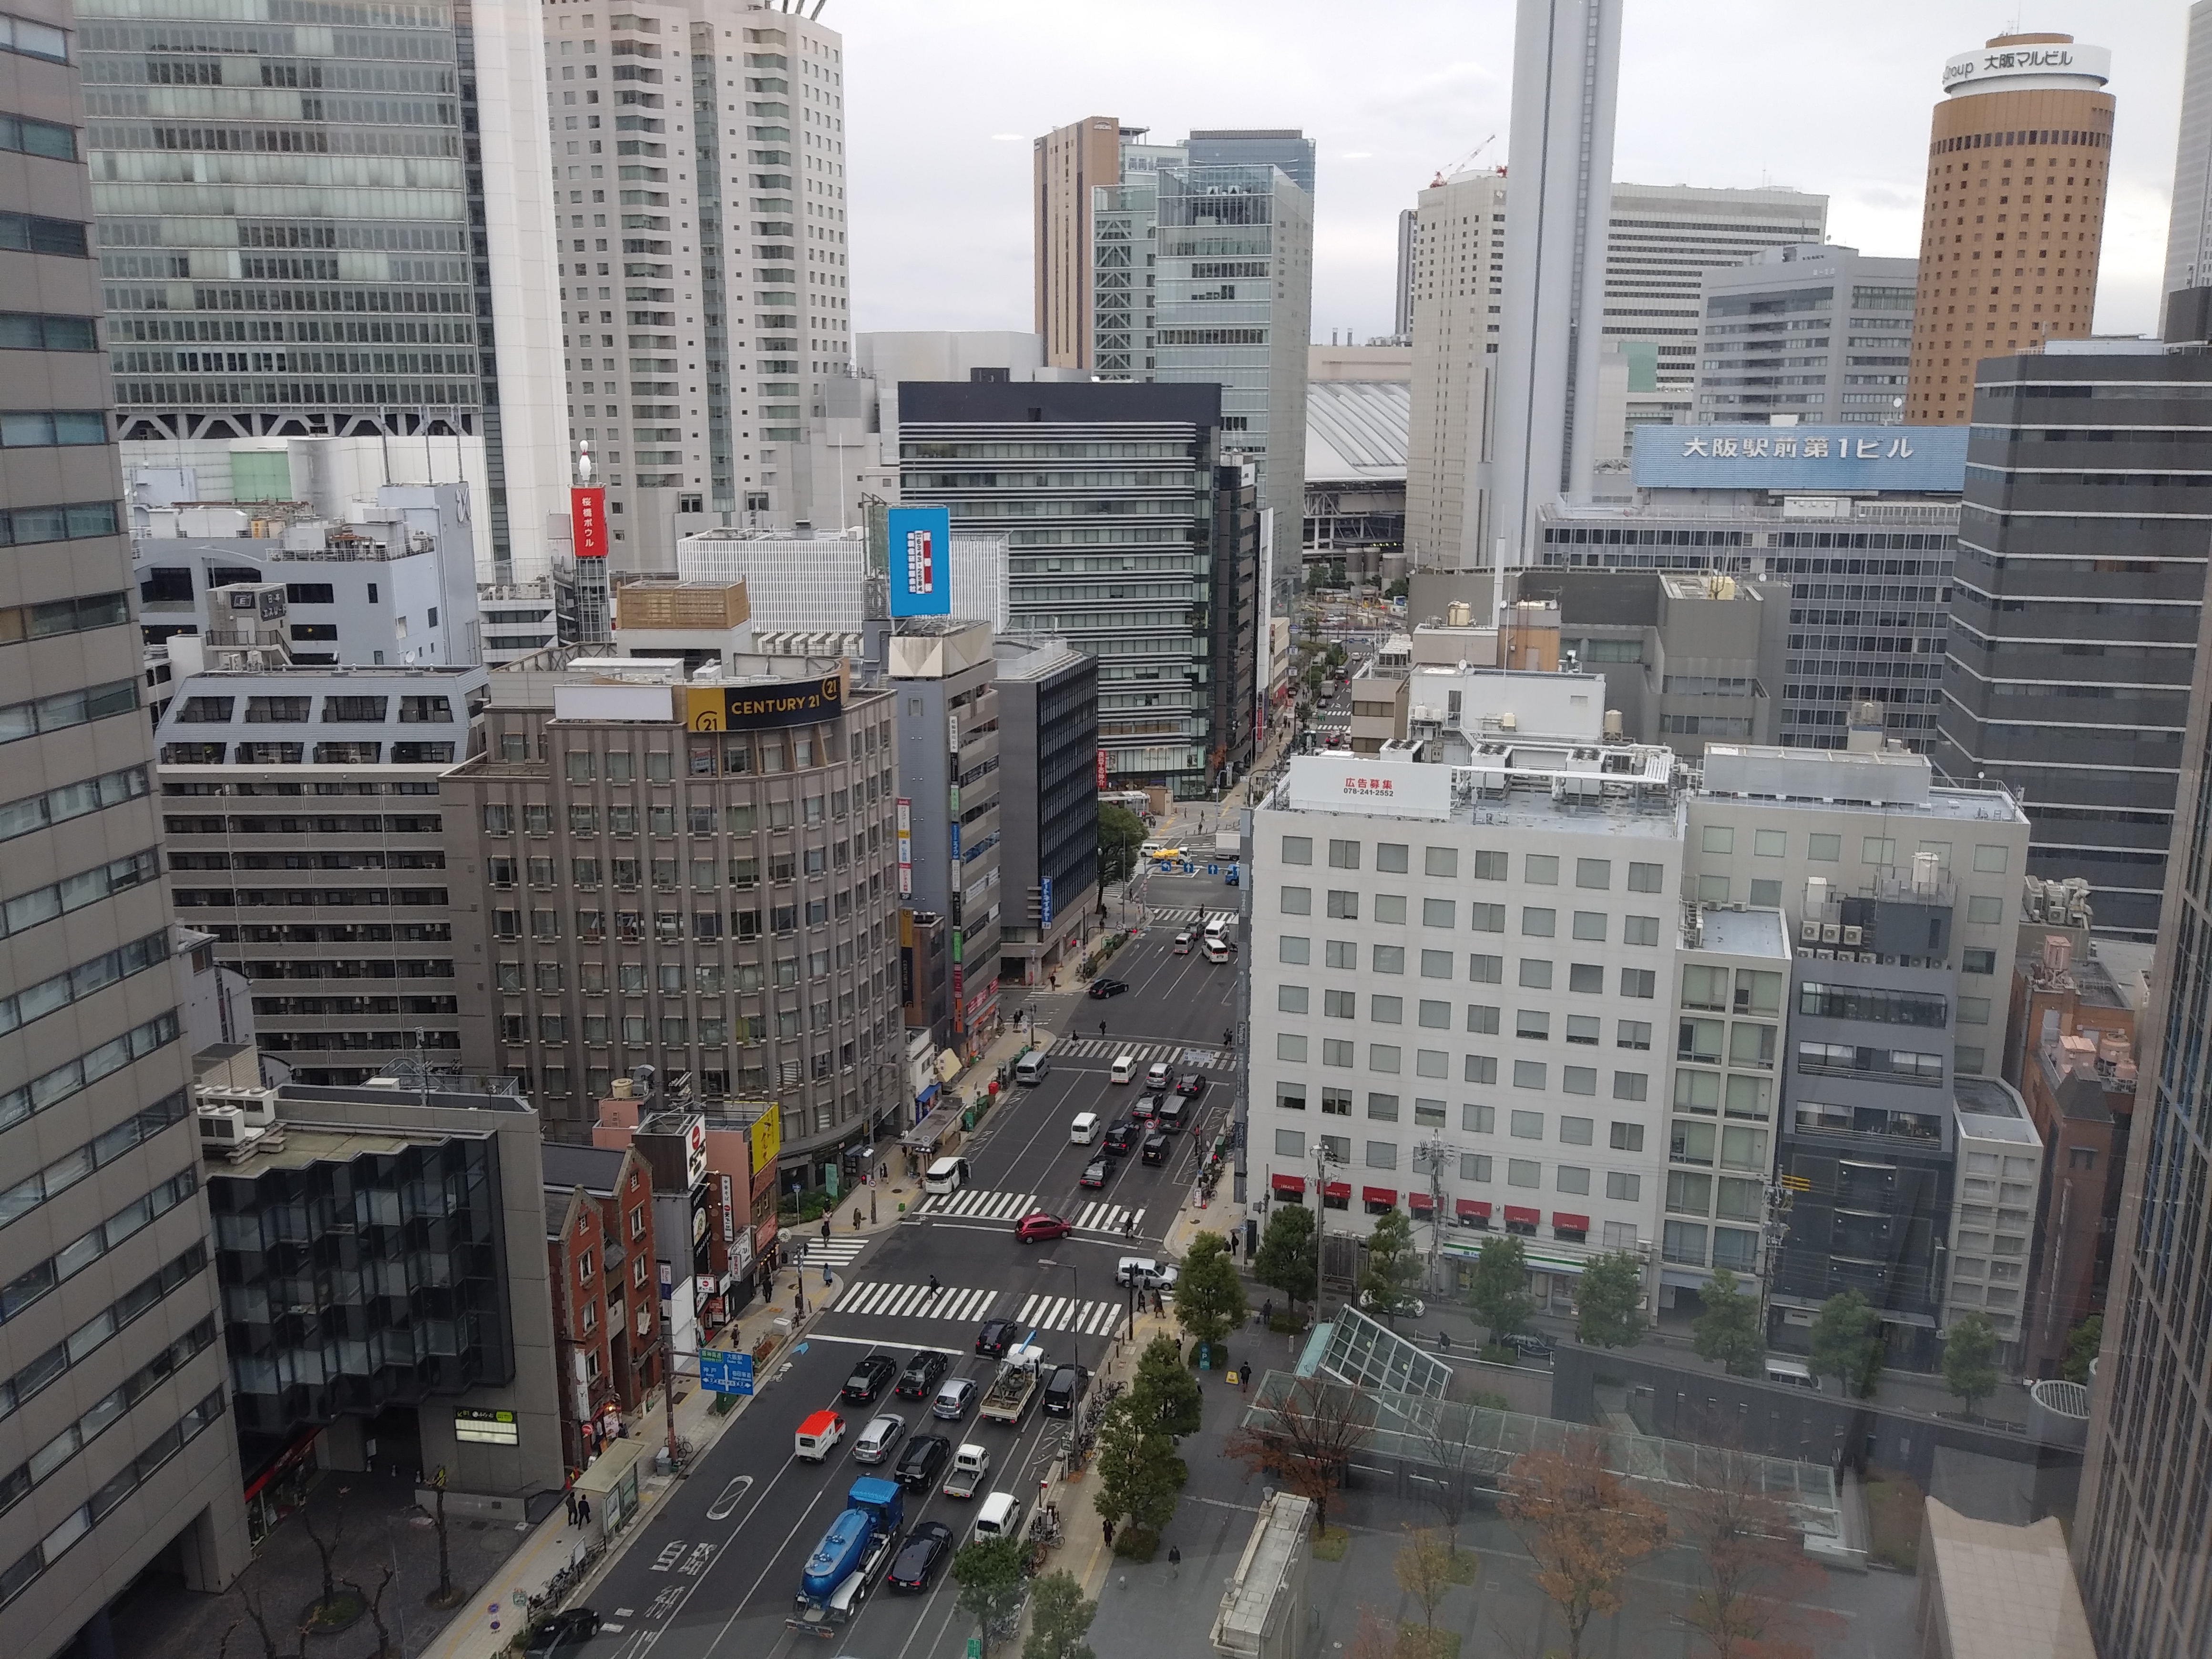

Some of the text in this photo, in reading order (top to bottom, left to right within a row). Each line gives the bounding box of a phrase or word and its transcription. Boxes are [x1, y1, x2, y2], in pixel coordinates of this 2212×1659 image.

[1984, 51, 2073, 71] 大阪マルビル
[1681, 436, 1914, 458] 大阪駅前第1ビル
[582, 497, 594, 548] 桜橋ボウル
[731, 695, 820, 715] CENTURY 21
[1343, 788, 1393, 797] 078-241-2552
[1345, 778, 1393, 789] 広告募集
[1028, 1423, 1066, 1481] タクシー
